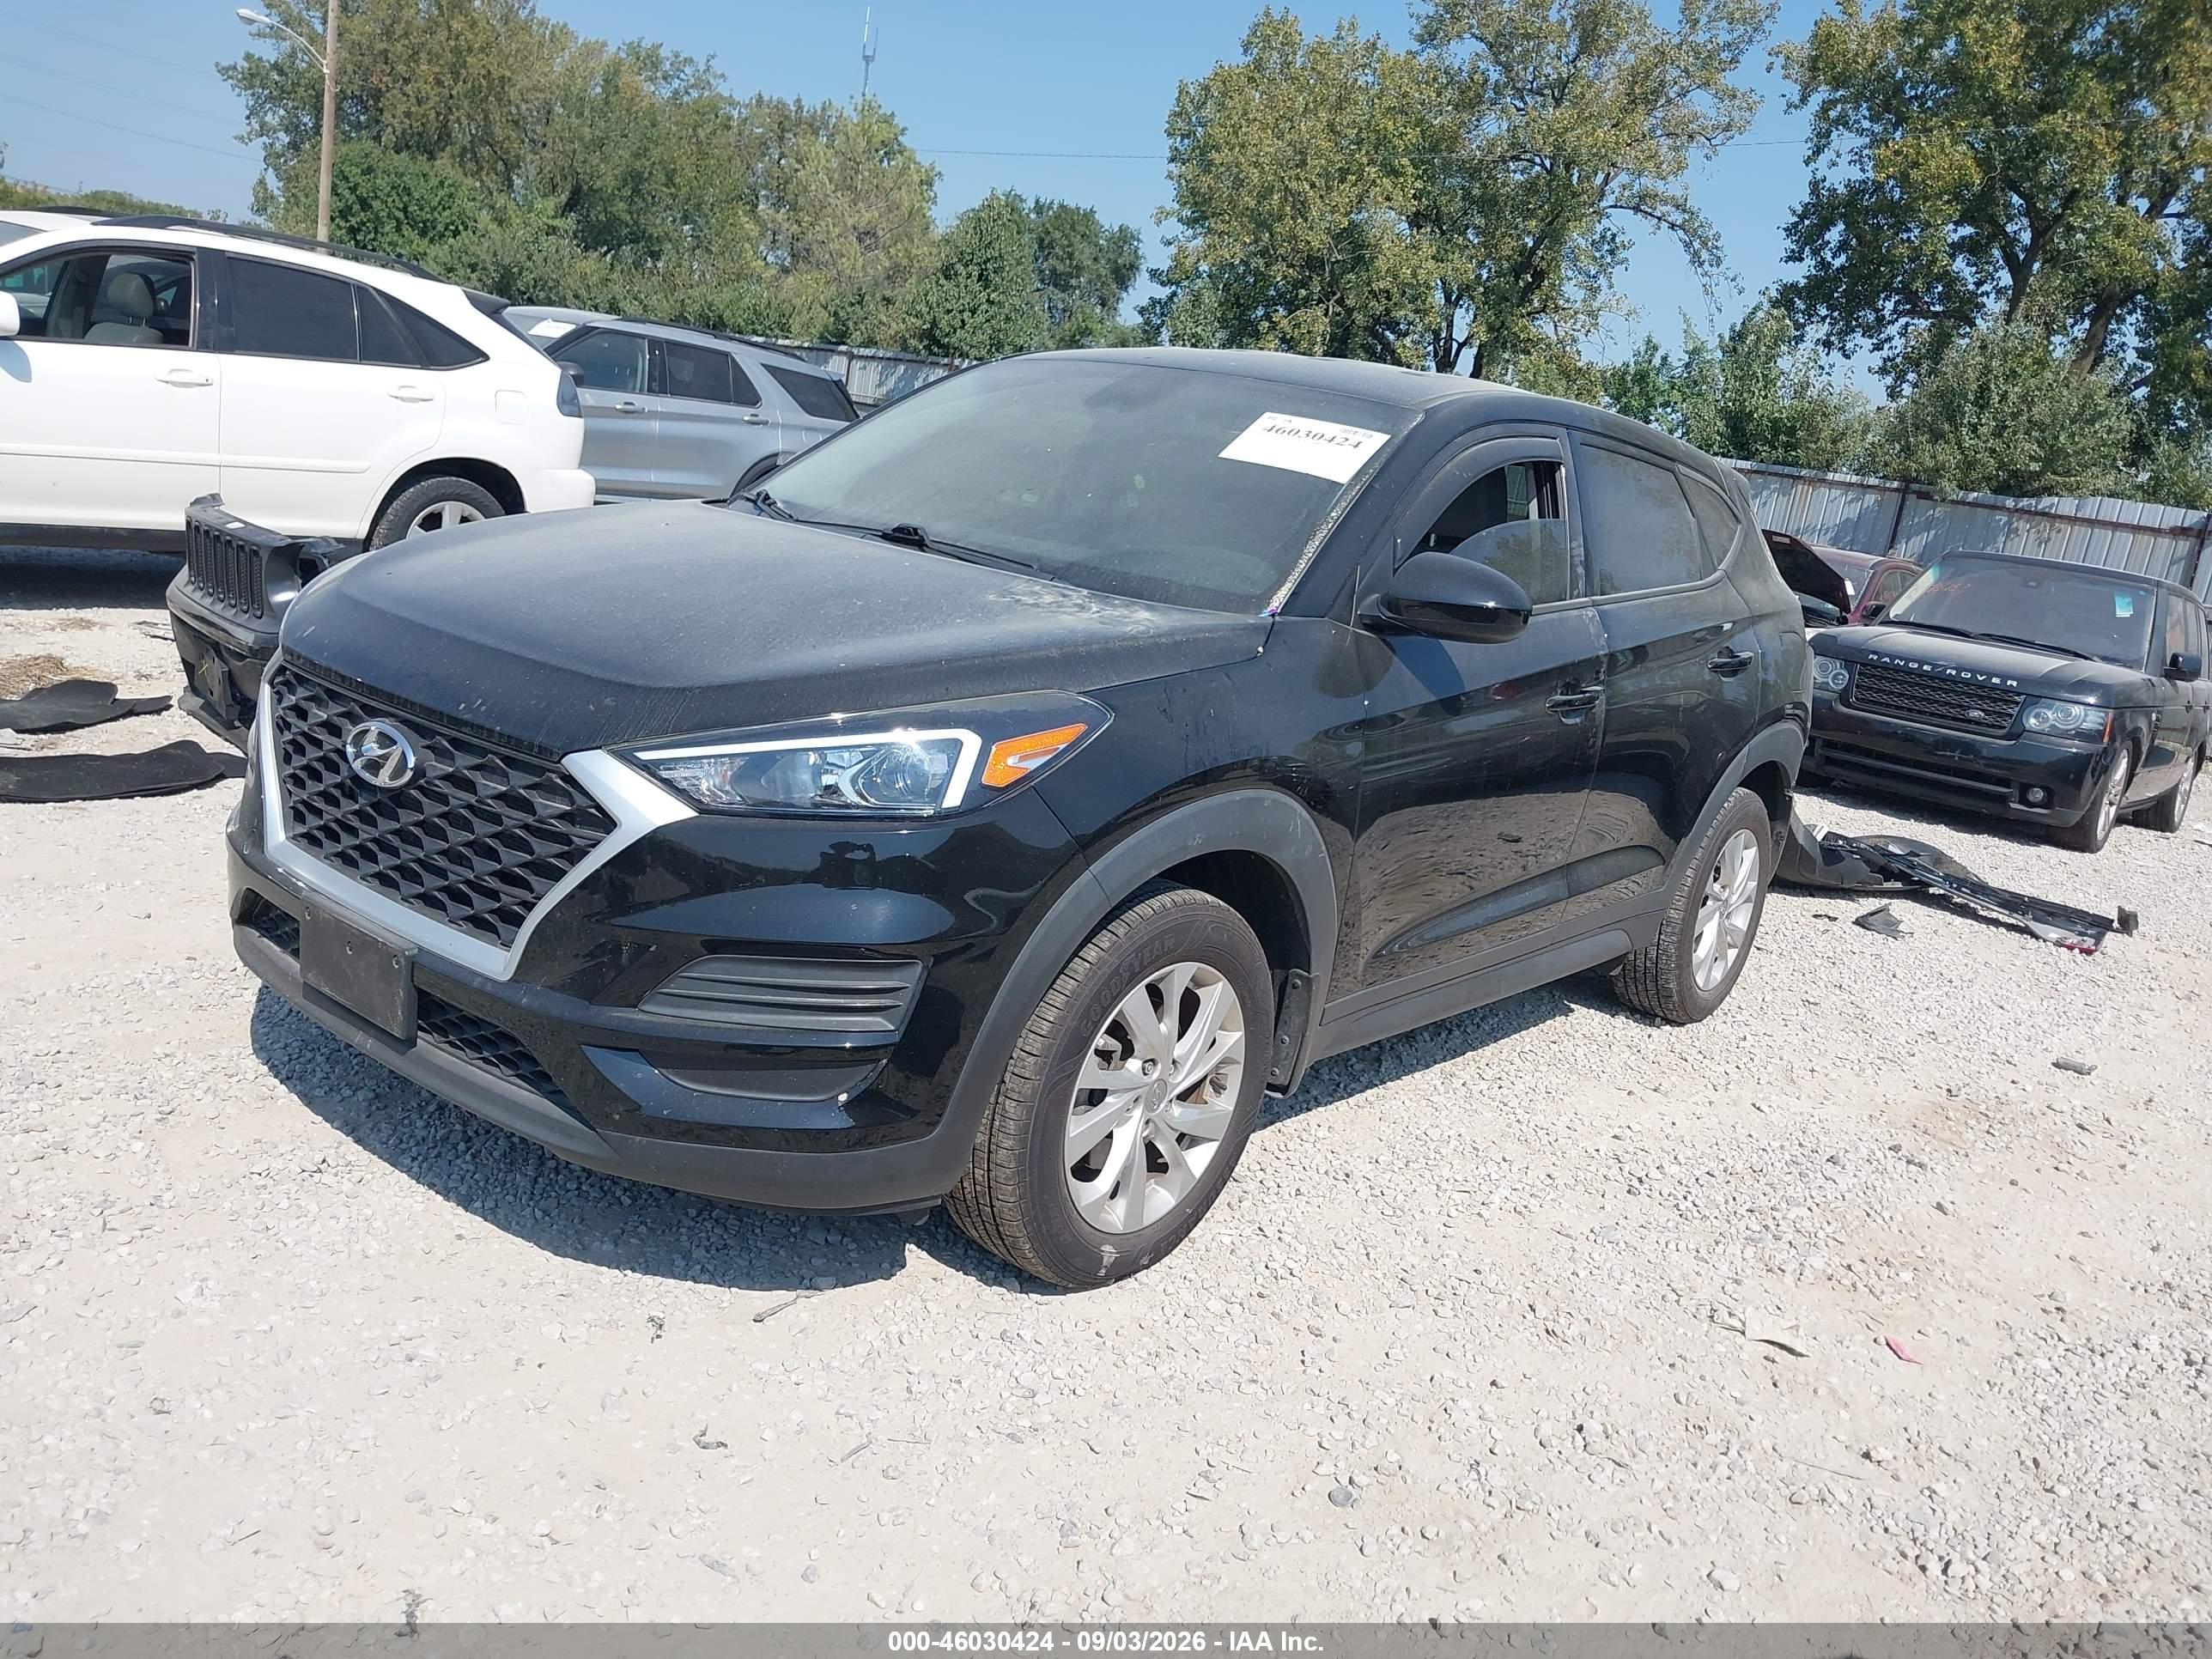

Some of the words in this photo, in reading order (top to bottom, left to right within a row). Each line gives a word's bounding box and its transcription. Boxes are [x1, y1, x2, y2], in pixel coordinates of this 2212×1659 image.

[1262, 424, 1363, 449] 46030424
[1868, 653, 1933, 672] RANGE
[1946, 668, 2018, 687] ROVER
[1080, 933, 1176, 1037] GOODYEAR
